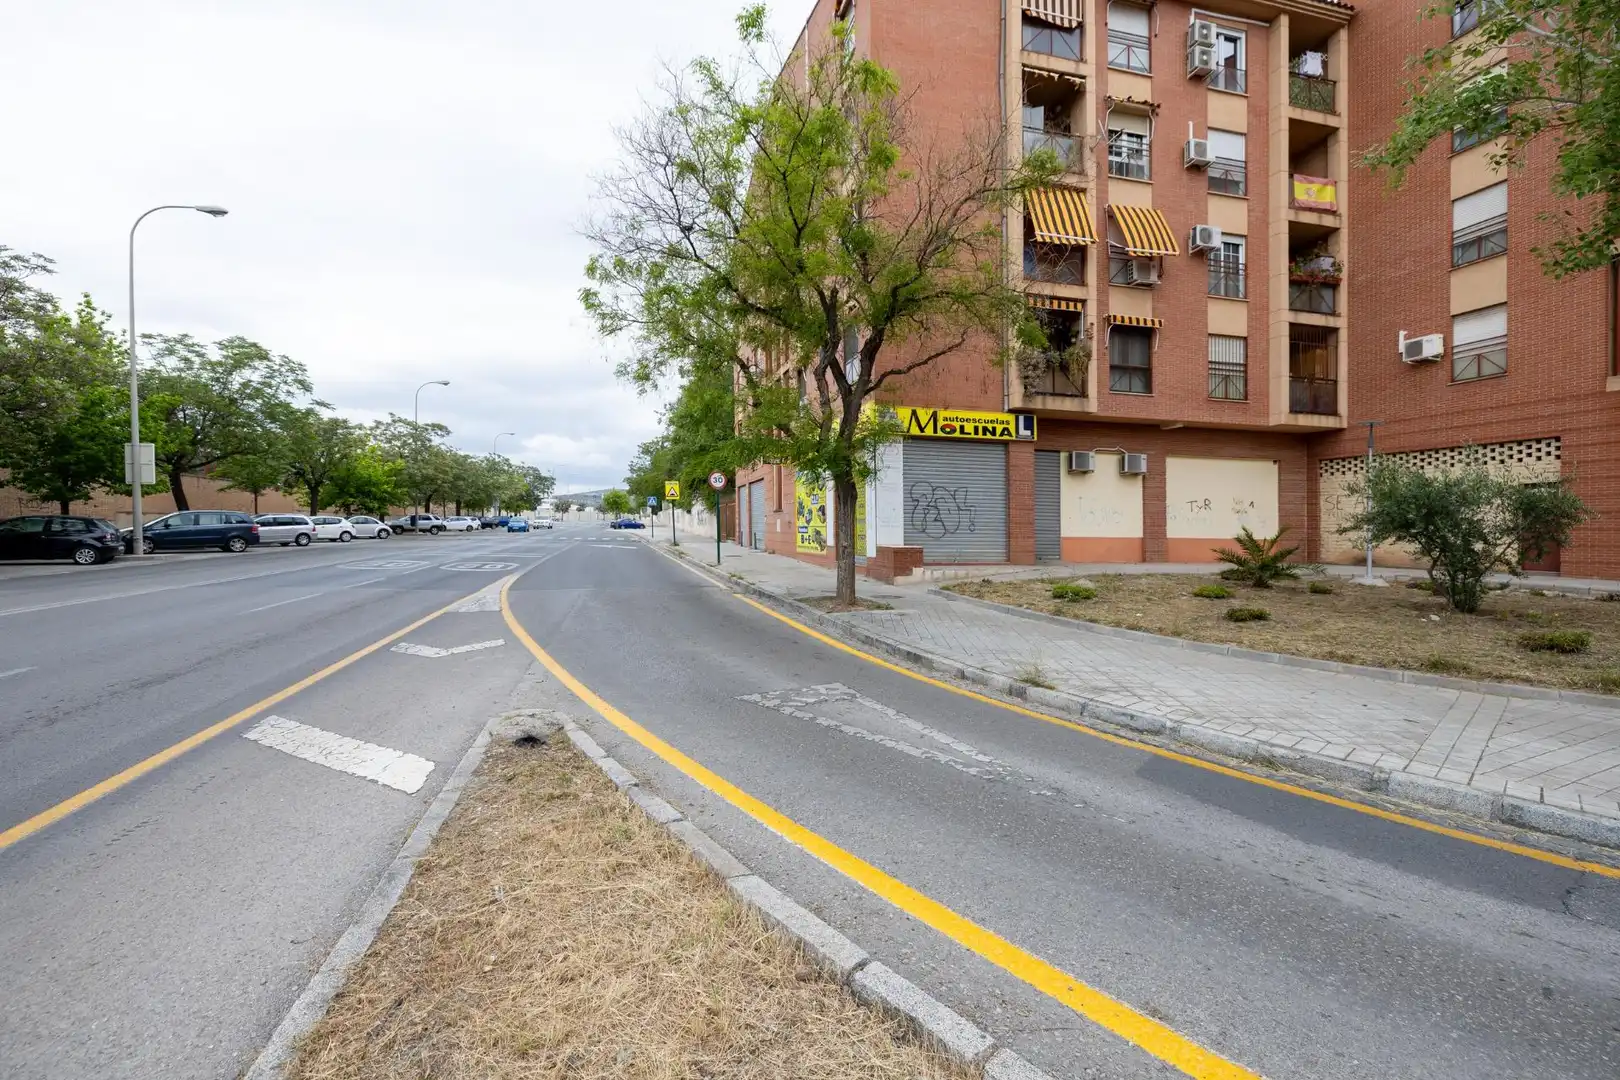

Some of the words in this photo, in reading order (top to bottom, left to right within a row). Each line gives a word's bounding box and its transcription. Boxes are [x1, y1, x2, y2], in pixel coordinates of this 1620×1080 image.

[907, 408, 1014, 438] MOLINA
[942, 415, 1011, 425] autoescuelas
[1018, 415, 1032, 436] L
[713, 476, 723, 484] 30
